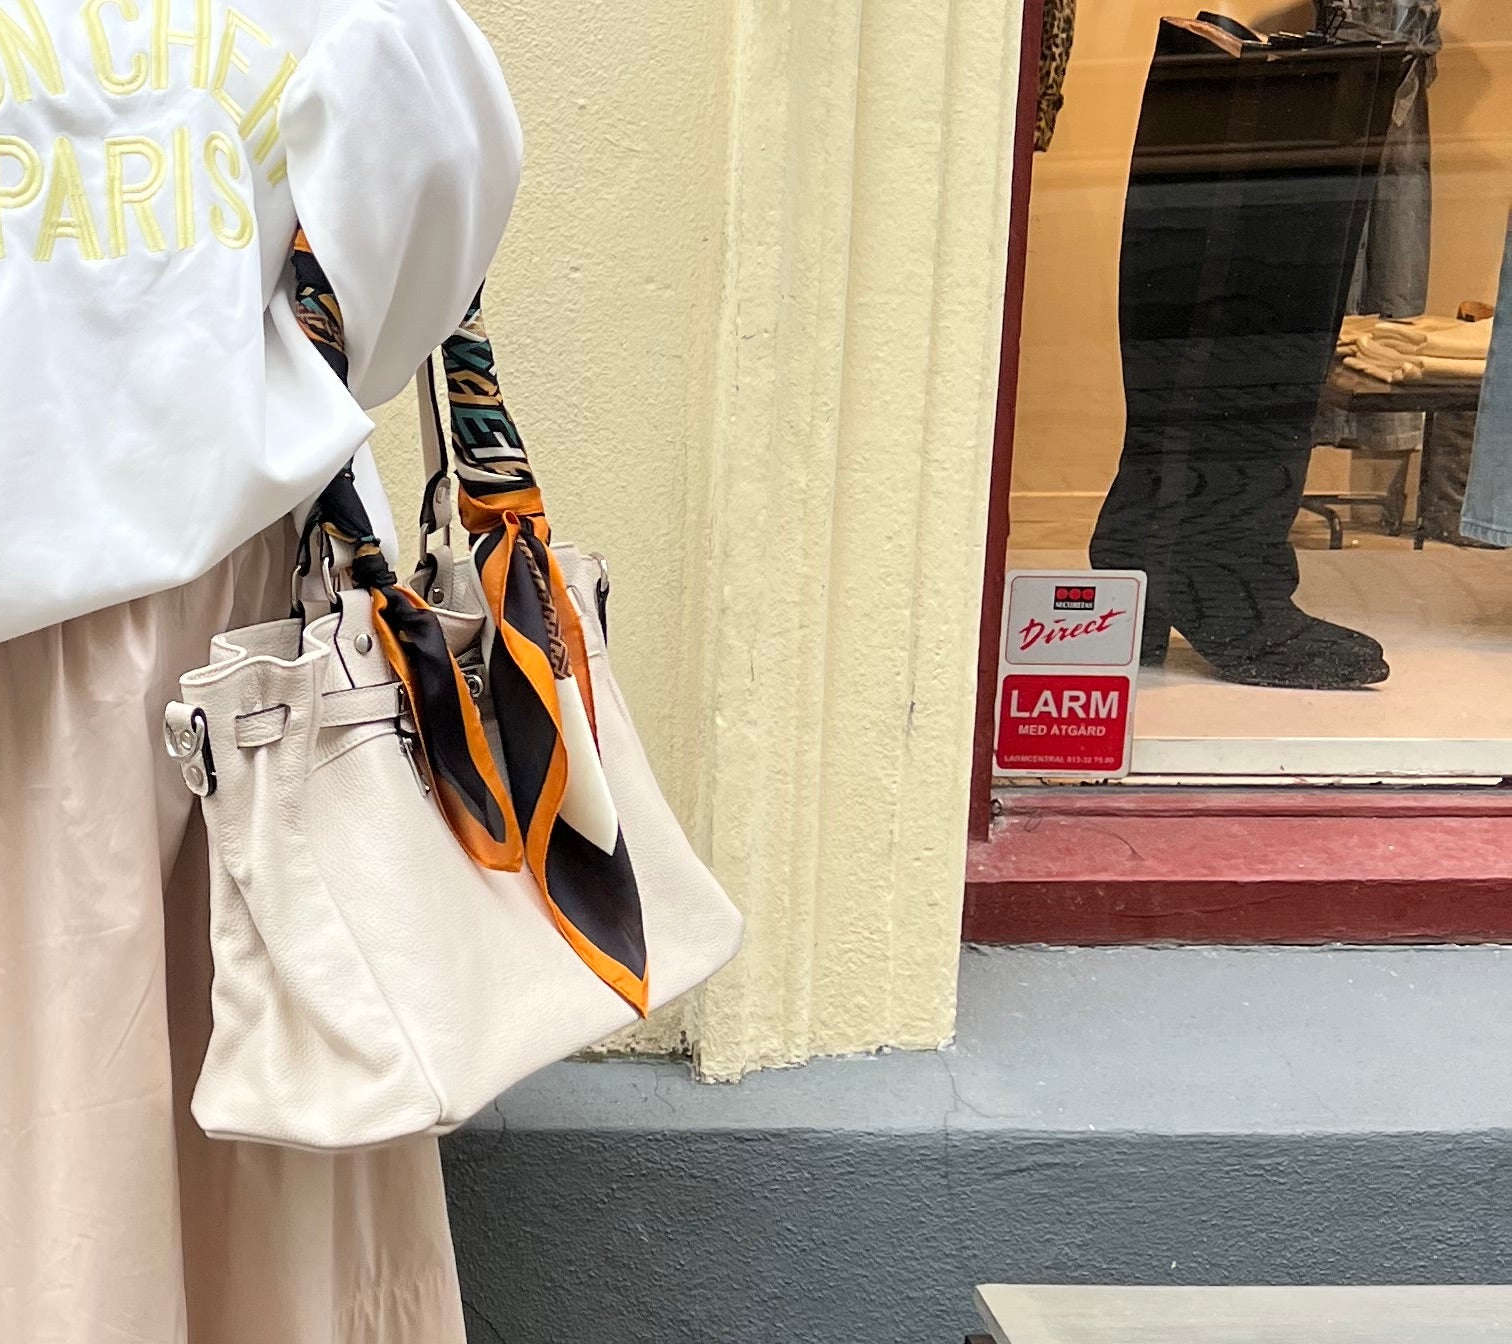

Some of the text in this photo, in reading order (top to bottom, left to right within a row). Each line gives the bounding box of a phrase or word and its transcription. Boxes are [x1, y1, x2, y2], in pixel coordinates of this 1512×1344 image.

[1018, 608, 1127, 651] Direct
[1009, 688, 1119, 720] LARM
[1018, 724, 1048, 736] MED
